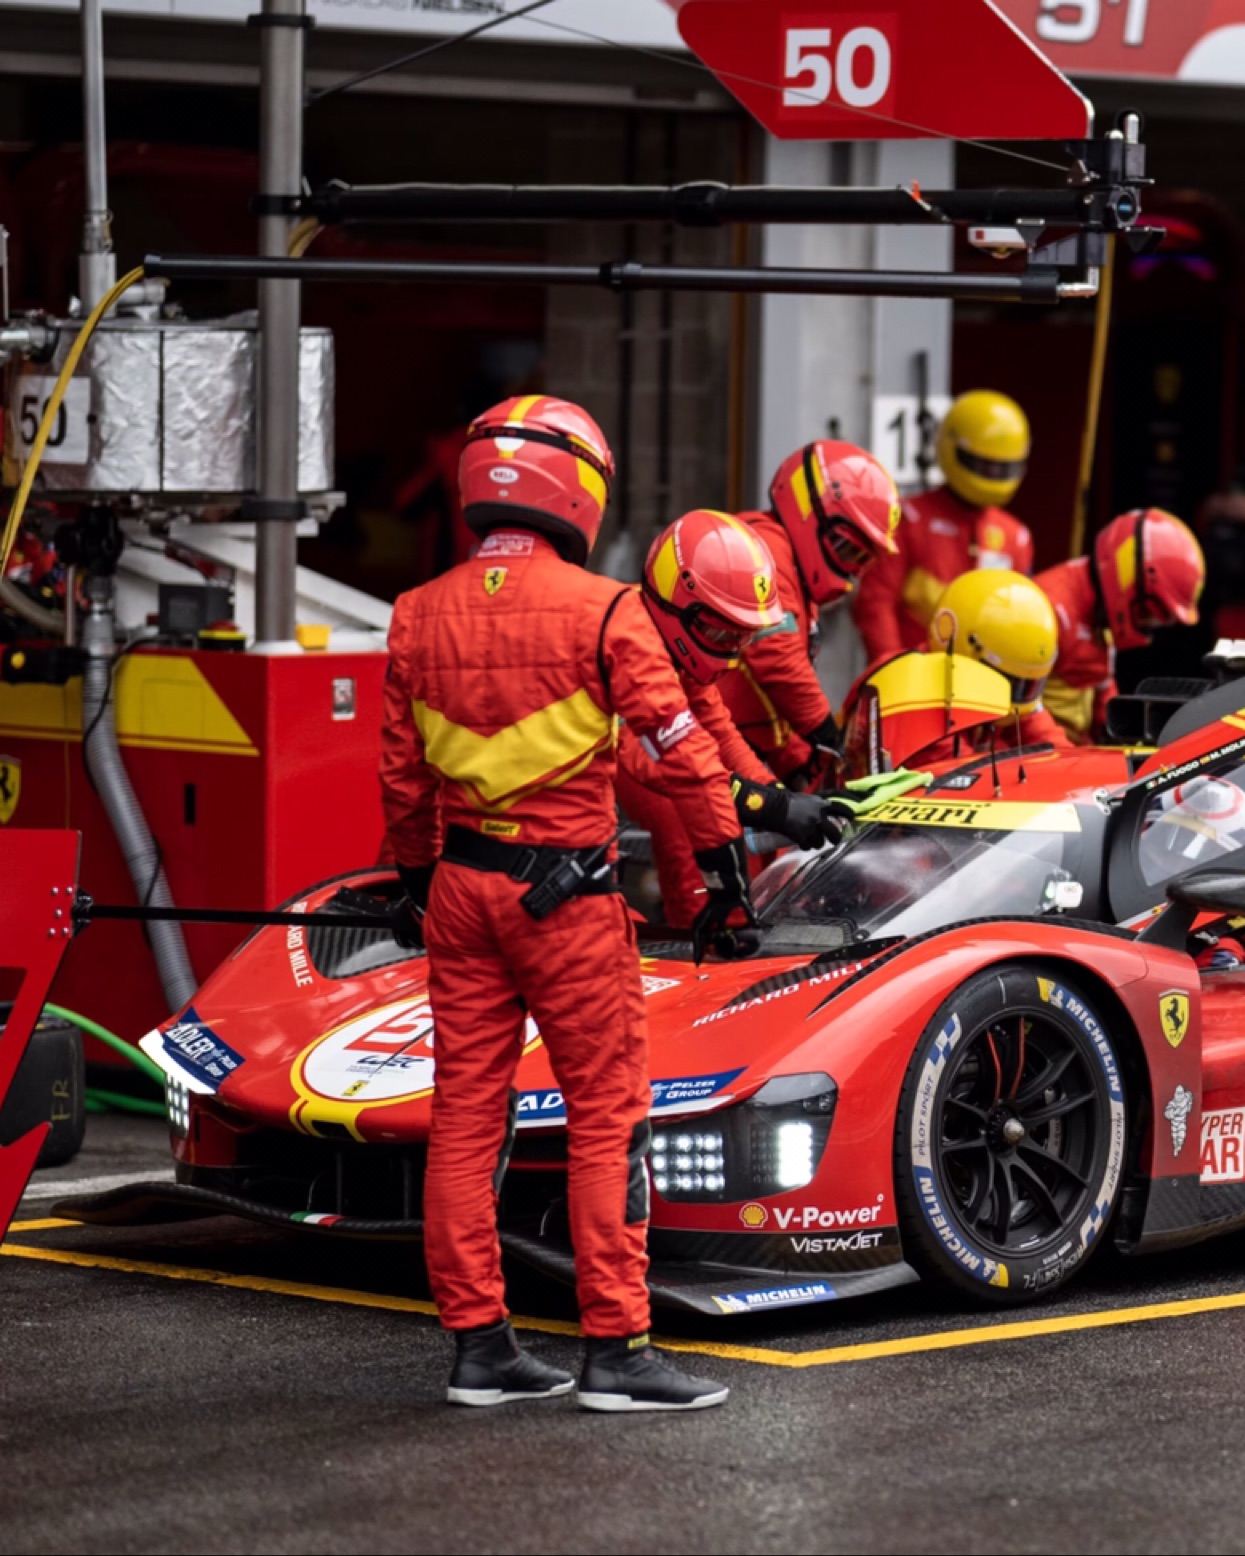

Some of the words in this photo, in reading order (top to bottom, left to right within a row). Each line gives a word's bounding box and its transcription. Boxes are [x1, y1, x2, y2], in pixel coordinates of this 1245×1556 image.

[782, 27, 891, 107] 50
[20, 395, 67, 447] 50
[1167, 761, 1200, 781] FUOCO
[288, 949, 313, 988] MILLE
[692, 984, 800, 1028] RICHARD
[165, 1022, 209, 1060] ADLER
[1065, 997, 1121, 1093] MICHELIN
[666, 1088, 712, 1099] GROUP
[669, 1080, 716, 1090] PELZER
[920, 1075, 934, 1118] SPORT
[917, 1119, 927, 1156] PILOT
[1201, 1112, 1244, 1137] YPER
[1201, 1138, 1241, 1174] AR
[773, 1203, 882, 1229] V-Power
[919, 1177, 982, 1272] MICHELIN
[790, 1230, 883, 1254] VISTAJET
[746, 1284, 827, 1305] MICHELIN
